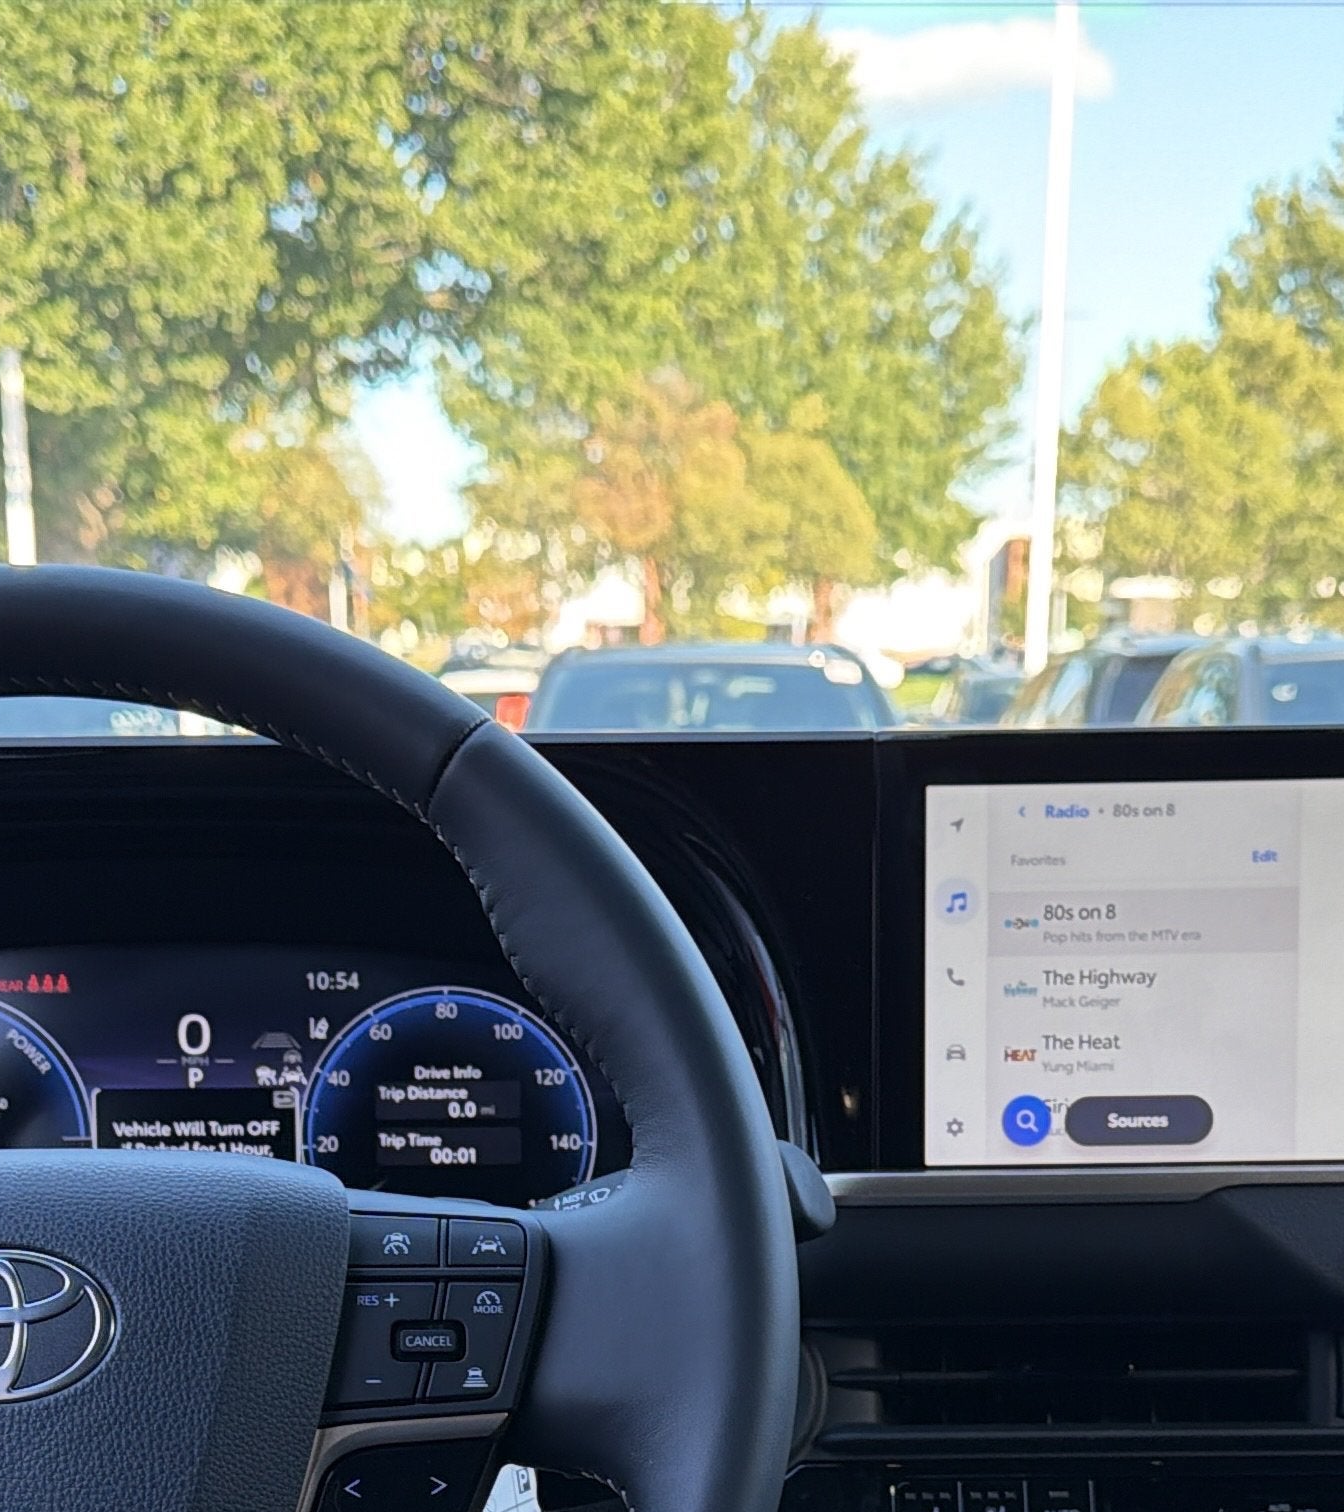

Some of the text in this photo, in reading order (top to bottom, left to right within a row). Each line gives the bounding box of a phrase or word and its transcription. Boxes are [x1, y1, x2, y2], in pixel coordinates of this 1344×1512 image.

[1045, 804, 1176, 818] Radio 80s on 8
[1010, 854, 1066, 867] Favorites
[1252, 851, 1278, 863] Edit
[1043, 904, 1116, 921] 80s on 8
[1043, 930, 1202, 945] Pop hits from the MTV era
[306, 971, 359, 990] 10:54
[1043, 970, 1157, 989] The Highway
[435, 1003, 457, 1019] 80
[1043, 996, 1121, 1010] Mack Geiger
[369, 1024, 392, 1041] 60
[493, 1024, 523, 1040] 100
[1042, 1034, 1120, 1050] The Heat
[6, 1028, 52, 1075] POWER
[414, 1065, 482, 1080] Drive Info
[1042, 1060, 1115, 1075] Yung Miami
[188, 1068, 204, 1088] P
[328, 1070, 350, 1087] 40
[535, 1069, 565, 1086] 120
[378, 1086, 468, 1103] Trip Distance
[448, 1101, 496, 1118] 0.0 mi
[112, 1120, 281, 1137] Vehicle Will Turn OFF
[1107, 1113, 1169, 1129] Sources
[317, 1136, 339, 1153] 20
[378, 1133, 442, 1149] Trip Time
[550, 1134, 581, 1151] 140
[430, 1148, 476, 1164] 00:01
[357, 1295, 380, 1306] RES
[473, 1305, 504, 1314] MODE
[406, 1336, 452, 1347] CANCEL
